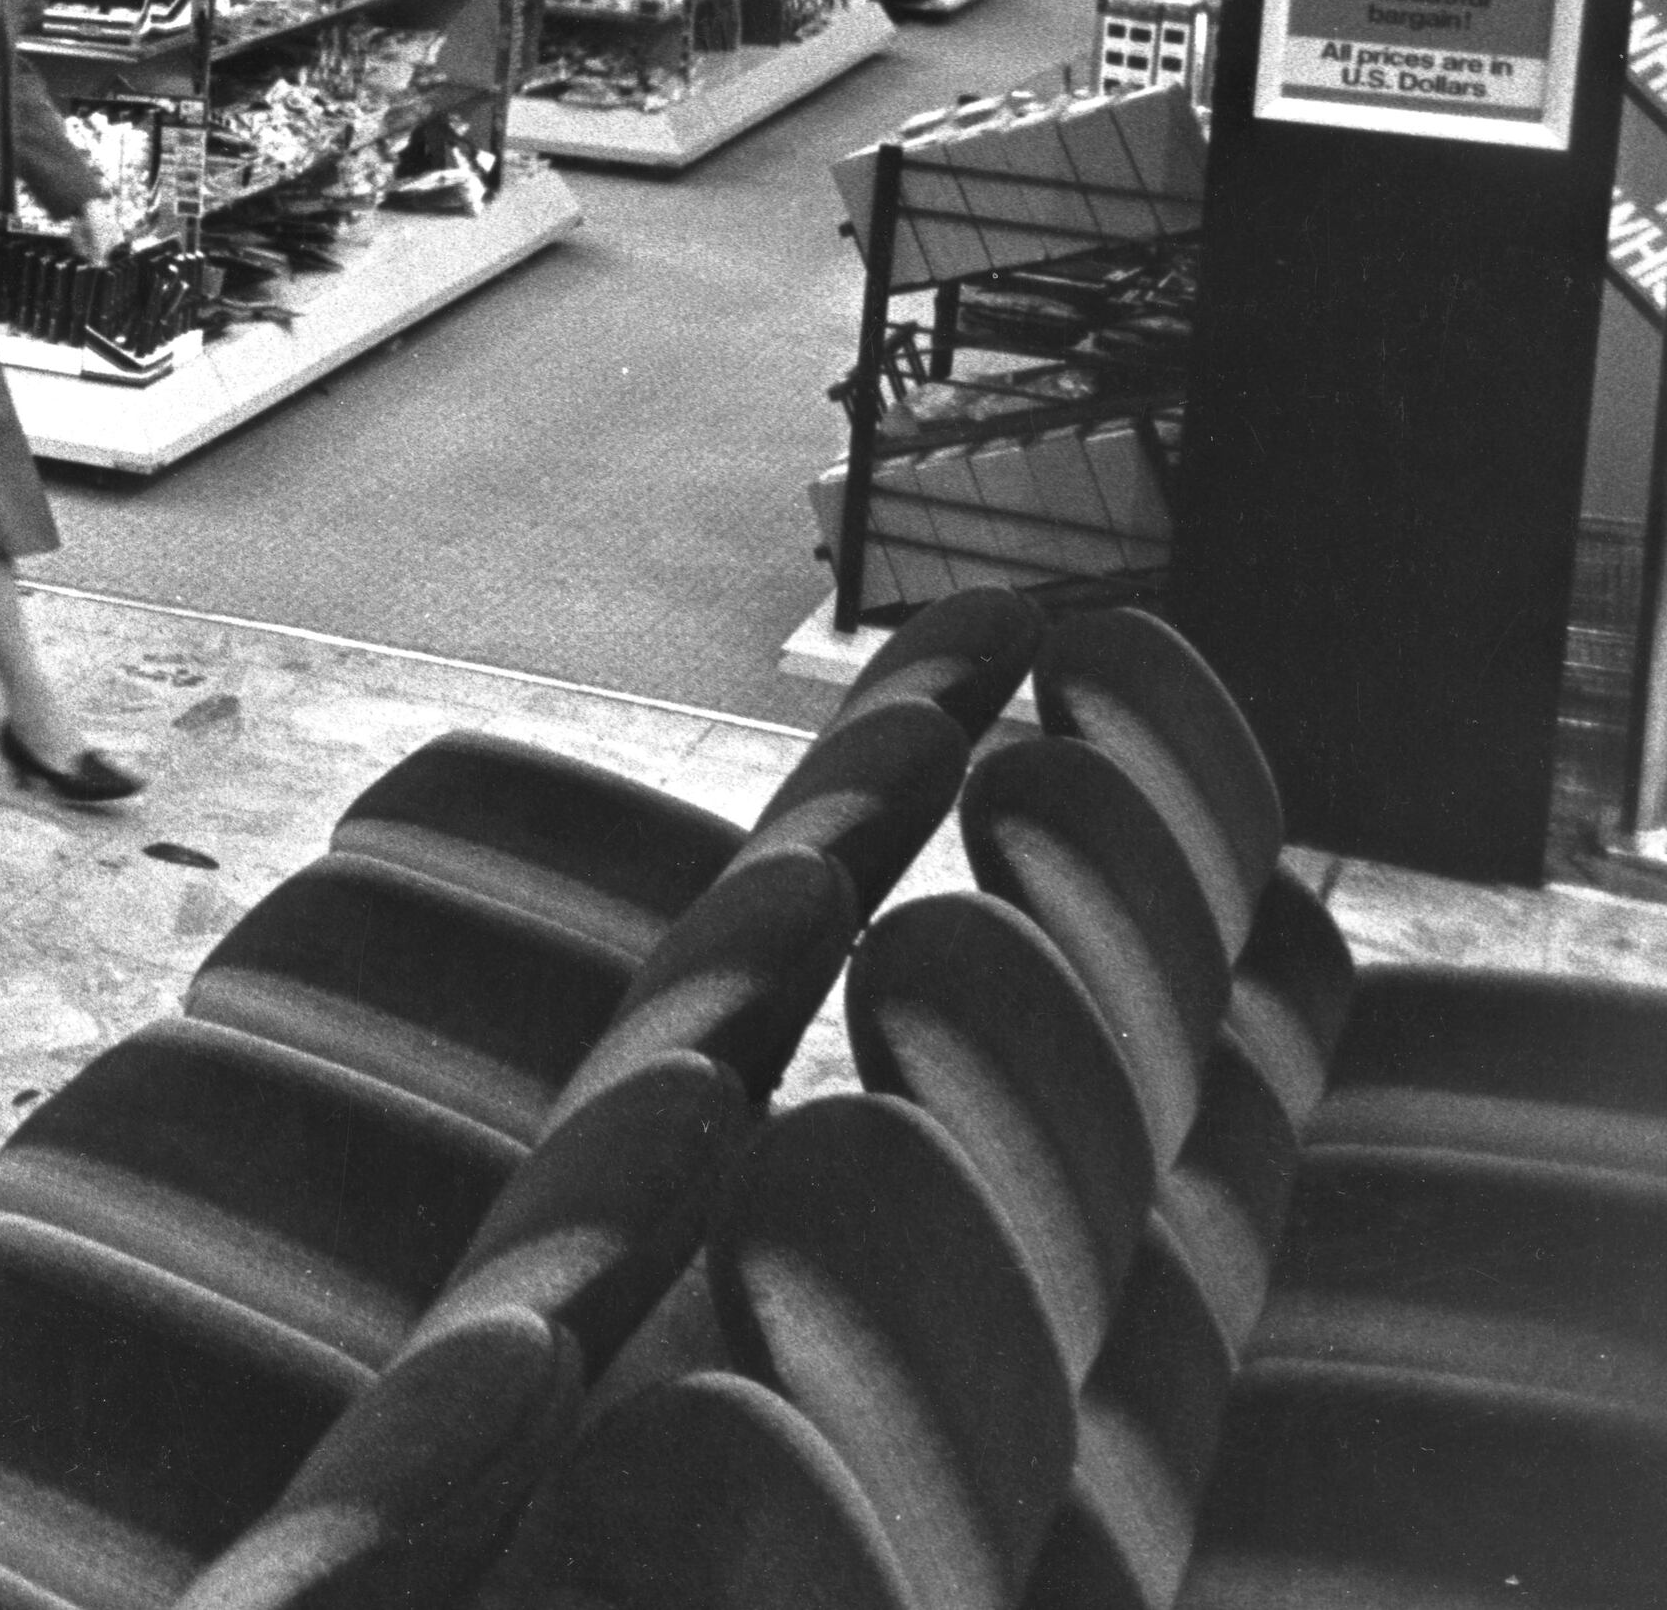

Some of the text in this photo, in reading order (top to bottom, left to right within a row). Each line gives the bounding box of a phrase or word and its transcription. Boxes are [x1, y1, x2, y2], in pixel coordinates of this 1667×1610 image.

[1369, 4, 1472, 32] bargain!
[1321, 41, 1513, 77] All prices are in
[1341, 66, 1486, 98] U.S. Dollars
